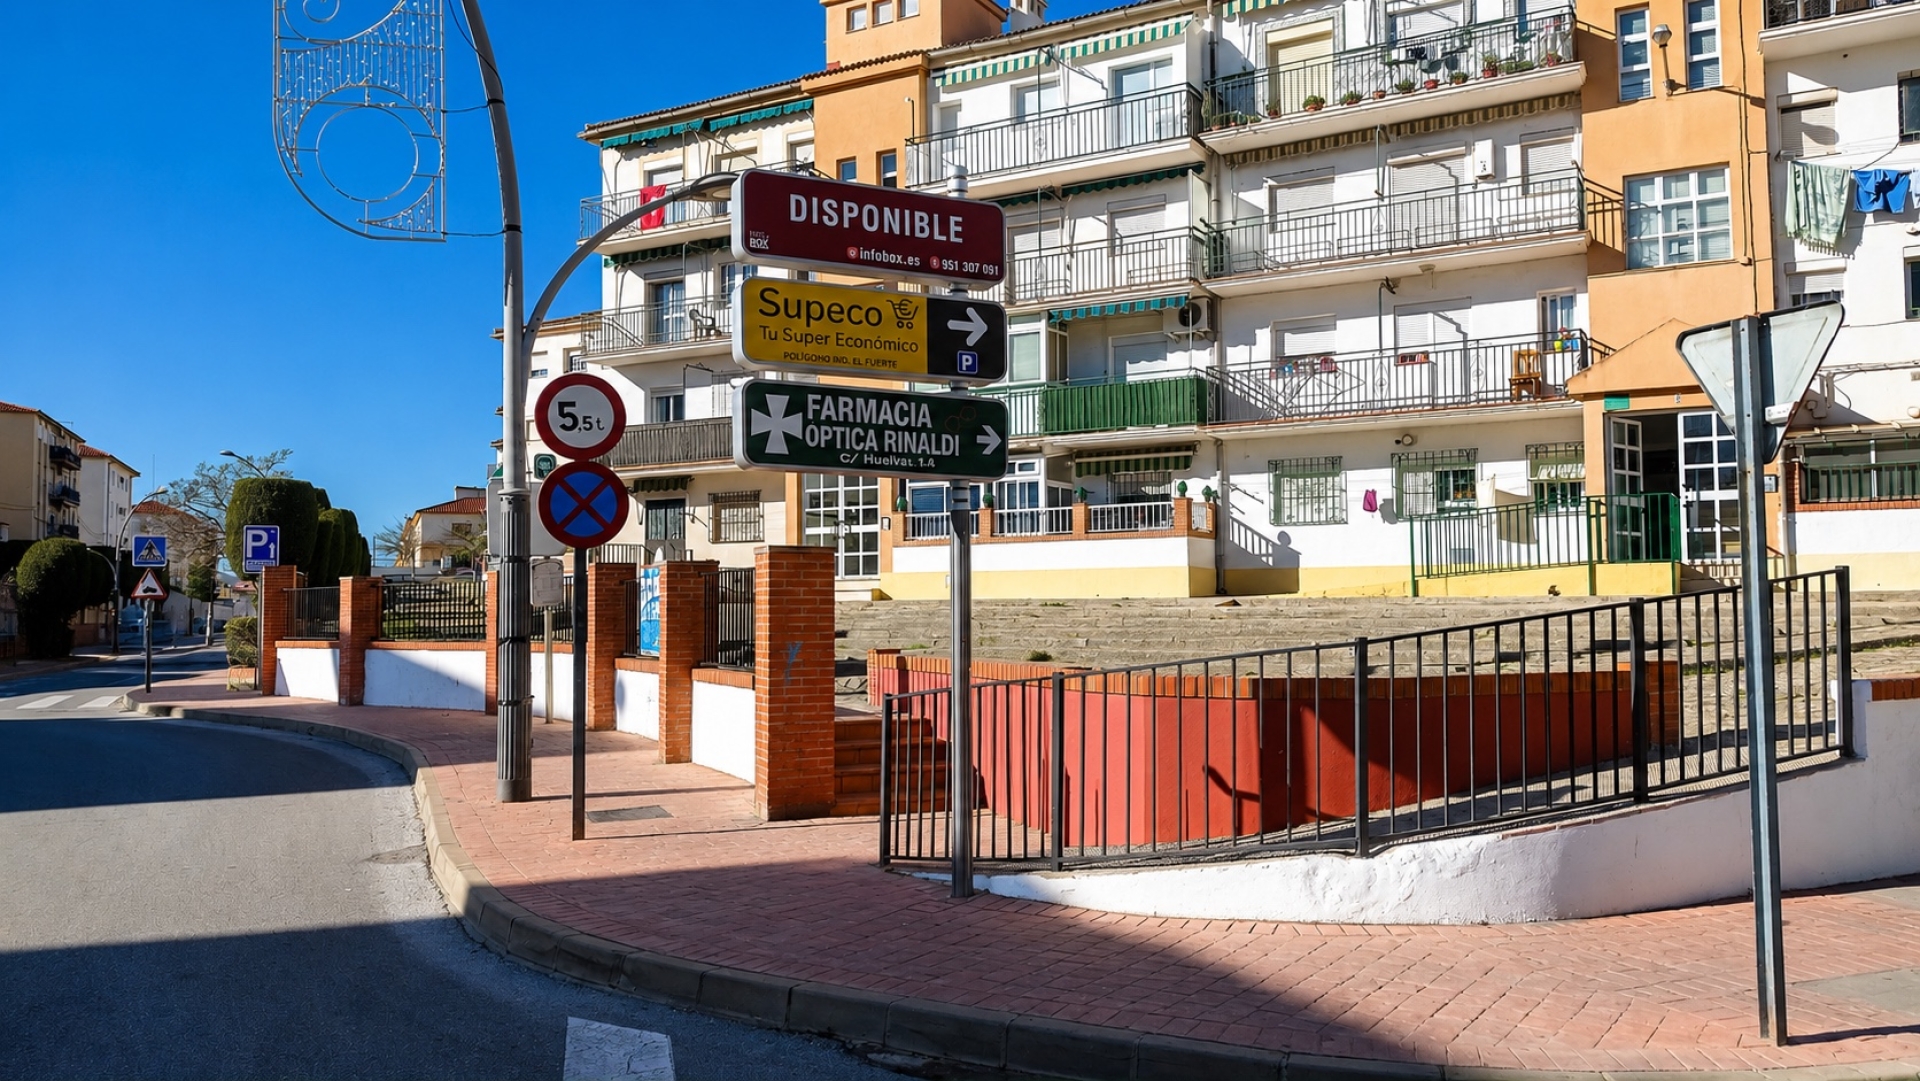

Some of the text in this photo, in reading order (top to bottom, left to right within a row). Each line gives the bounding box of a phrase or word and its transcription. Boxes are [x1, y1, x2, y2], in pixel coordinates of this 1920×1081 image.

[789, 193, 964, 244] DISPONIBLE
[859, 246, 921, 267] infobox.es
[942, 258, 999, 276] 951 307 091
[758, 287, 883, 328] Supeco
[759, 325, 919, 353] Tu Super Económico
[852, 356, 863, 365] EL
[865, 358, 898, 369] FUERTE
[961, 354, 973, 370] P
[806, 393, 933, 429] FARMACIA
[595, 417, 605, 431] t
[883, 429, 960, 457] RINALDI
[840, 453, 859, 464] C/
[246, 529, 269, 558] P
